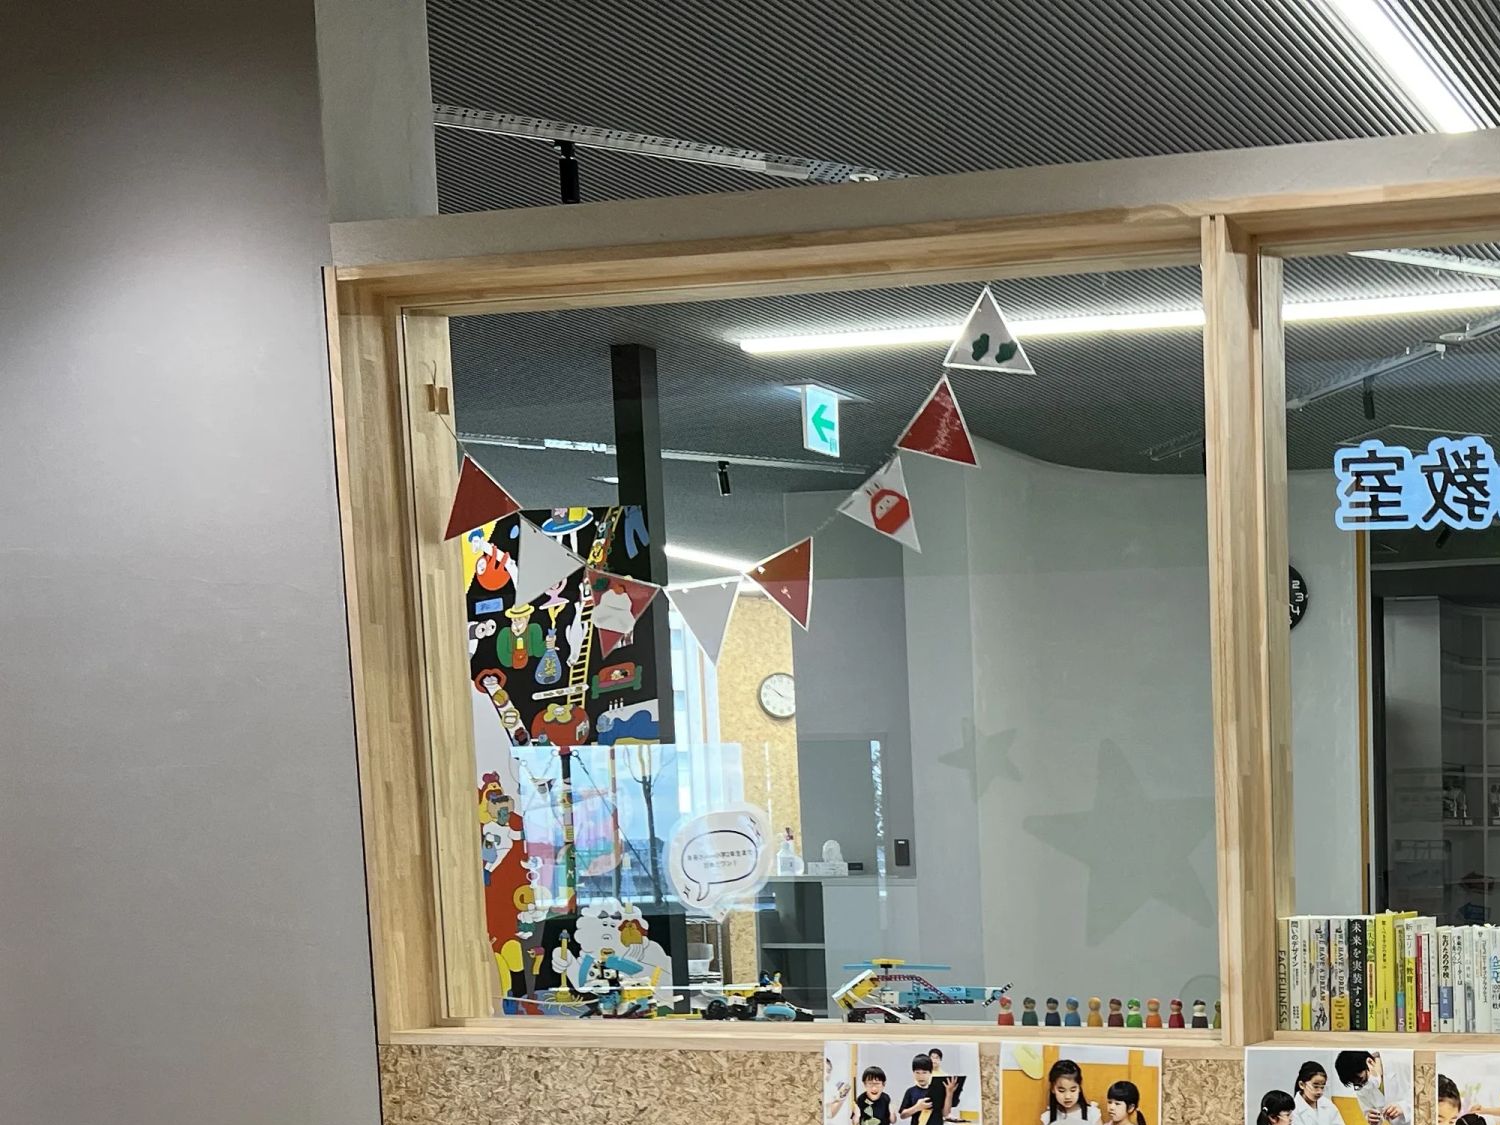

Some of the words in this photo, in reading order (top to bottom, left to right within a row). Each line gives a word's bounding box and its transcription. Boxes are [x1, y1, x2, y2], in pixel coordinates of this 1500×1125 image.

[1279, 950, 1288, 1024] FACTFULNESS
[1352, 921, 1362, 1007] 未来を実装する
